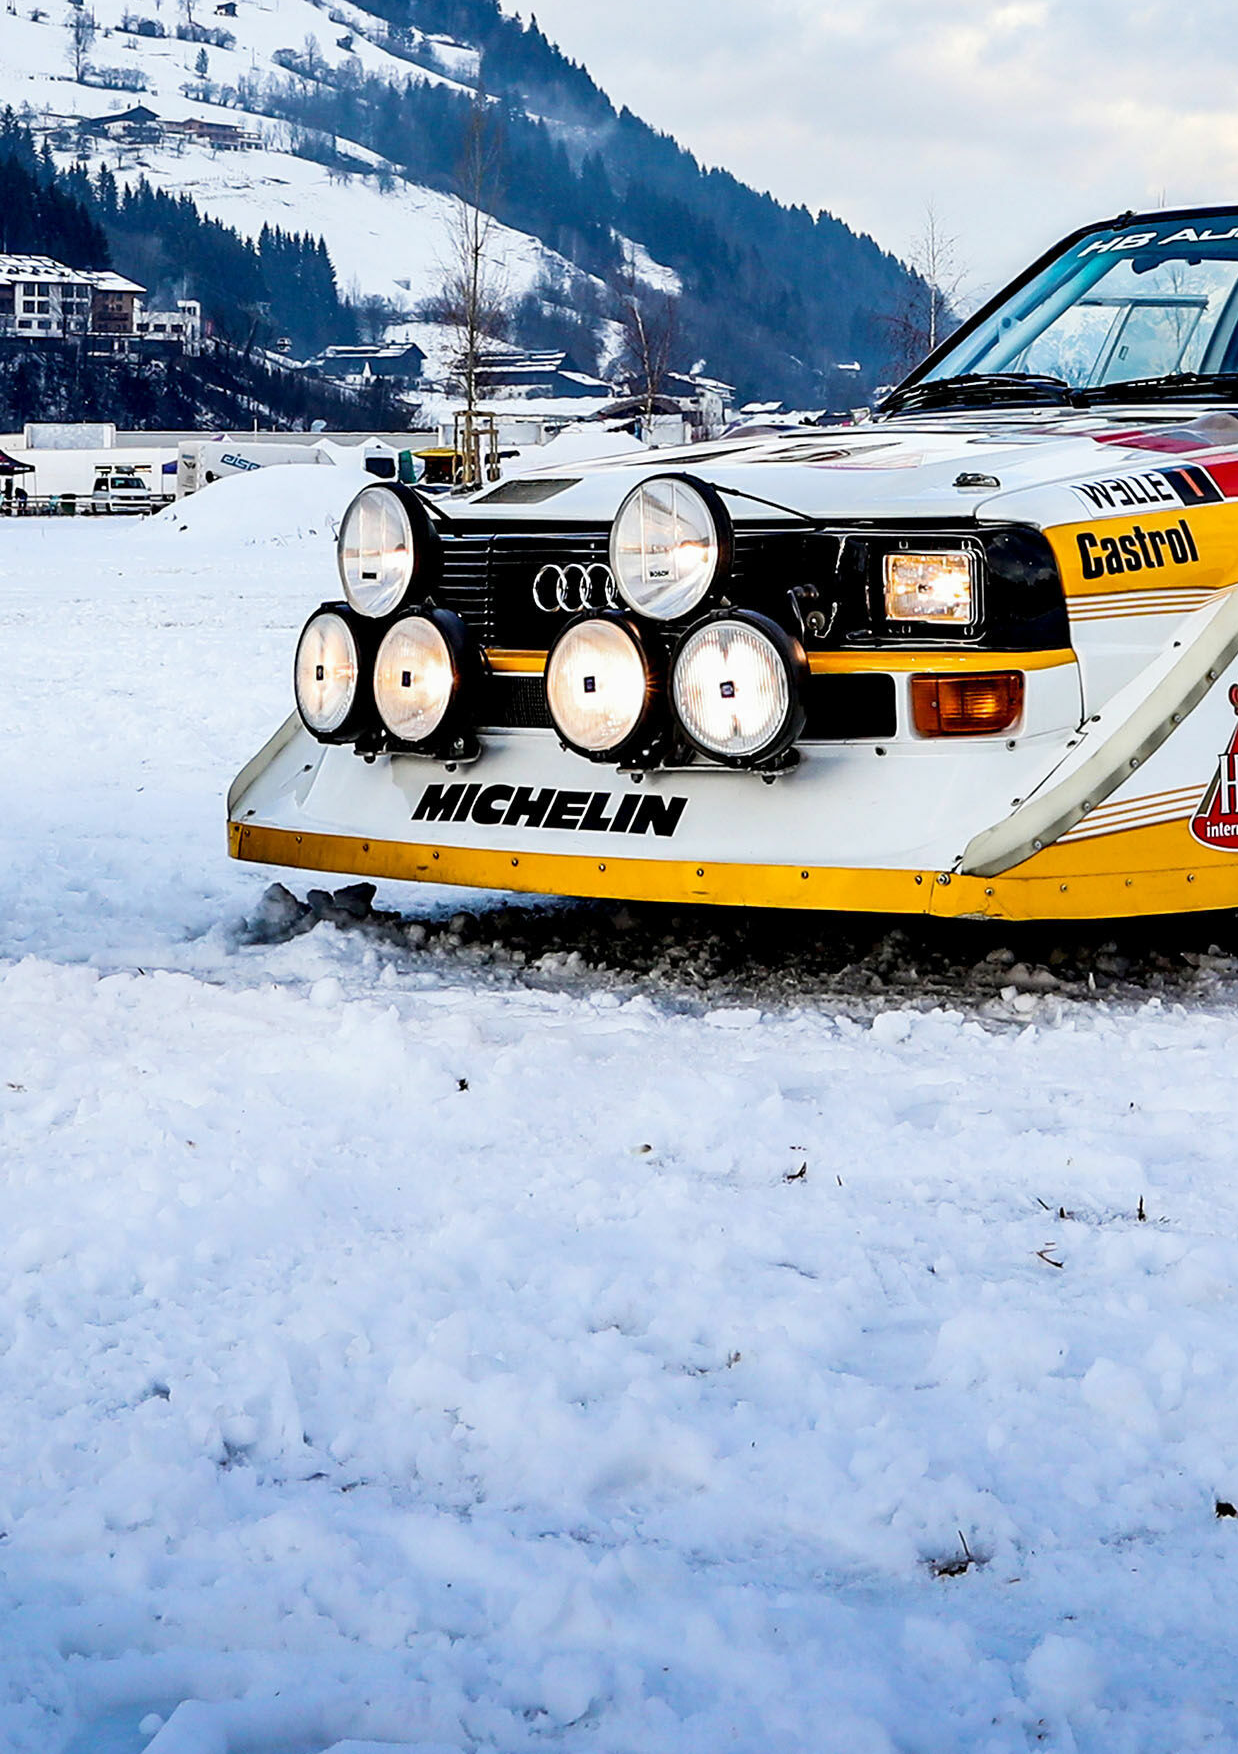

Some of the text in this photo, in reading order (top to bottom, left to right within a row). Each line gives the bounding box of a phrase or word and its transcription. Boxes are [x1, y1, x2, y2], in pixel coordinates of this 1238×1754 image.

[1077, 231, 1157, 258] HB
[1076, 518, 1200, 580] Castrol
[411, 783, 689, 838] MICHELIN
